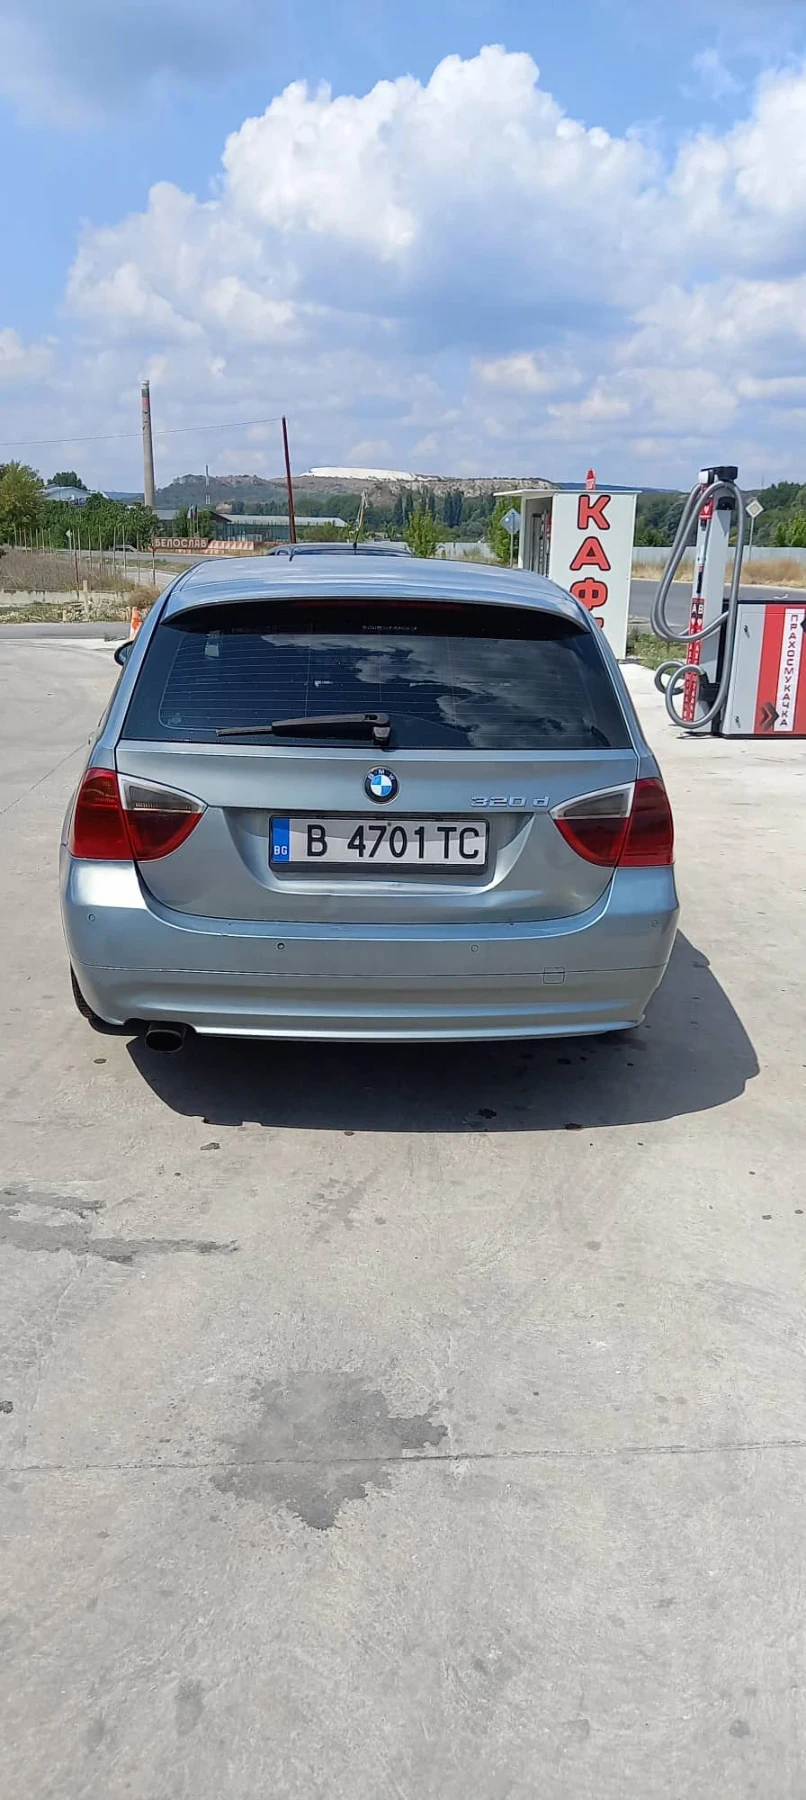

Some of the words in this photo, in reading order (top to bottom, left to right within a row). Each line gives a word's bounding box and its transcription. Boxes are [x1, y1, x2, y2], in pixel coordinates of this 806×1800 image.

[569, 494, 612, 629] КАФ
[780, 614, 798, 727] ПРАХОСМУКАЧКА
[470, 796, 527, 807] 320
[533, 795, 550, 807] d
[273, 845, 288, 855] BG
[307, 824, 328, 857] B
[347, 825, 425, 859] 4701
[437, 827, 480, 859] TC
